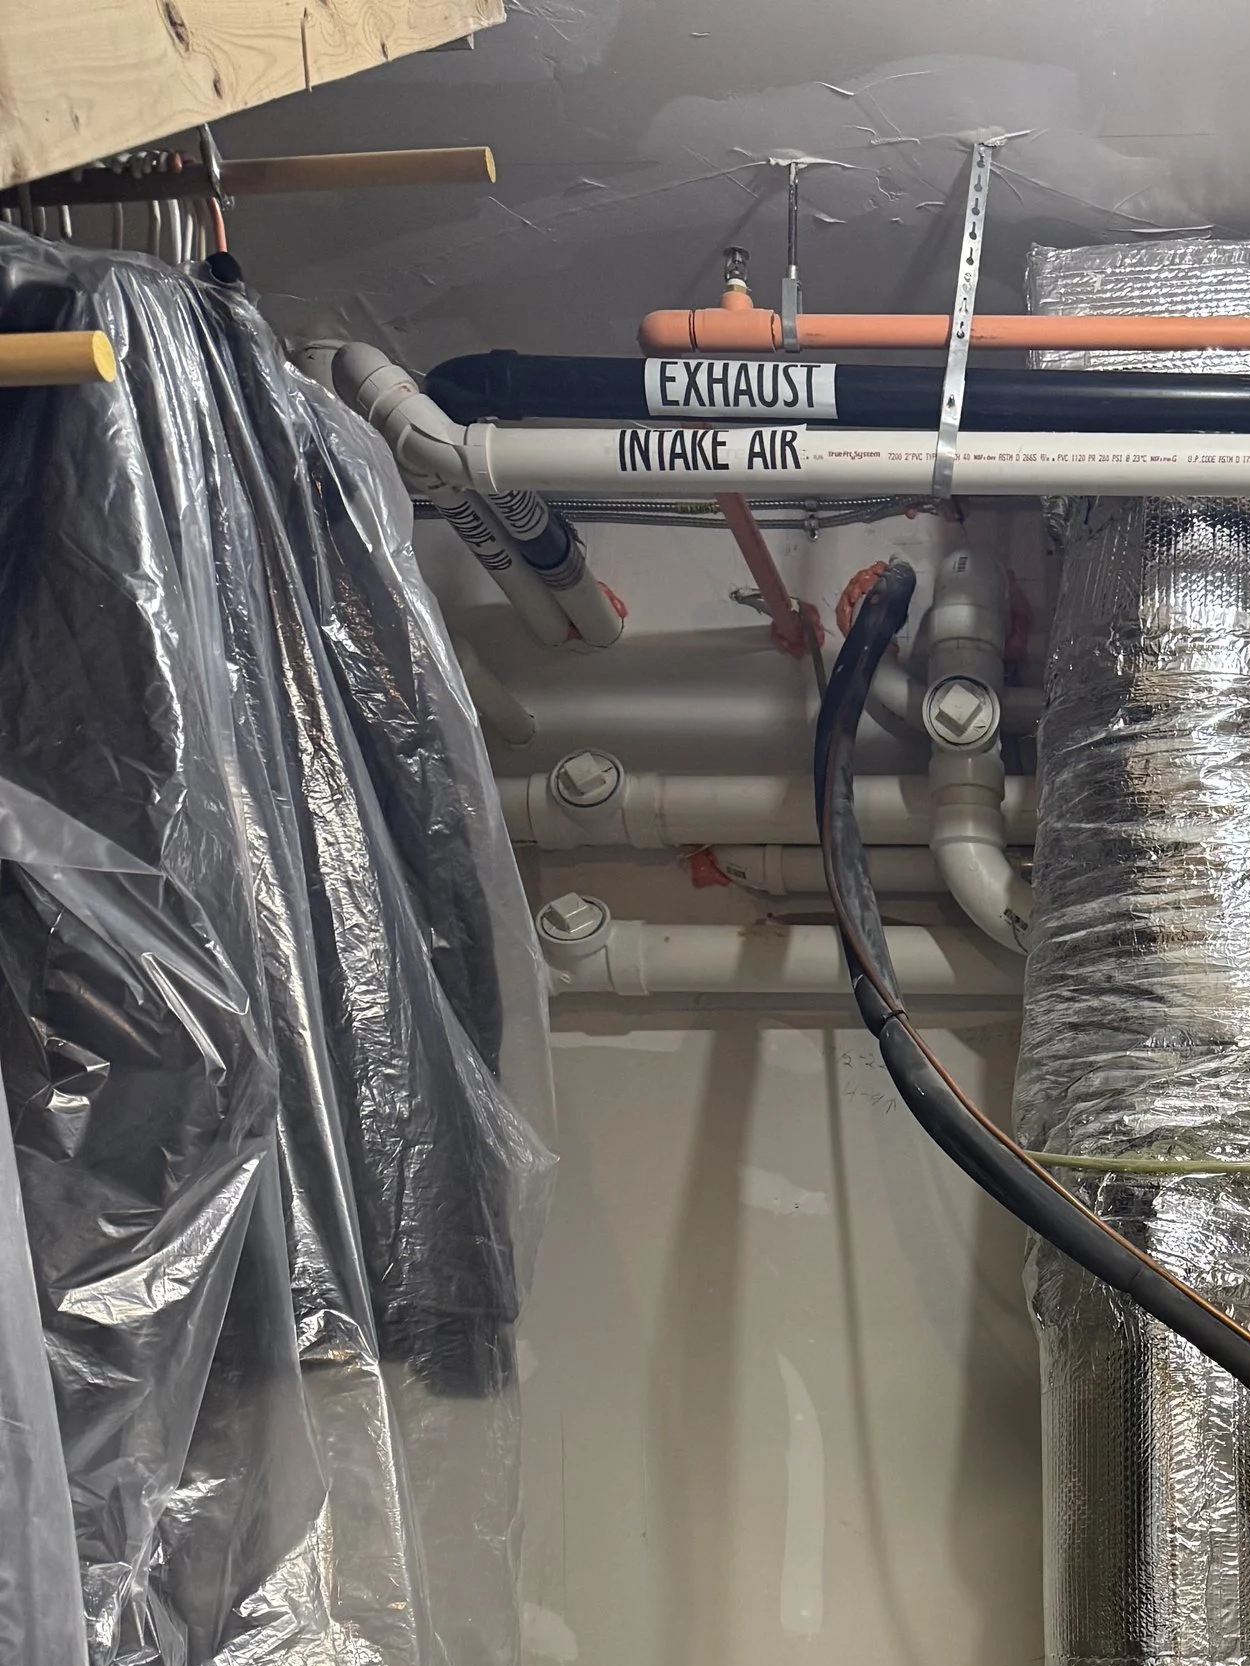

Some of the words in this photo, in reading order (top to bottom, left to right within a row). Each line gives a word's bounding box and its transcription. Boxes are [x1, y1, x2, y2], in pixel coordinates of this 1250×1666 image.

[660, 361, 821, 408] EXHAUST
[619, 430, 730, 472] INTAKE
[747, 430, 801, 470] AIR
